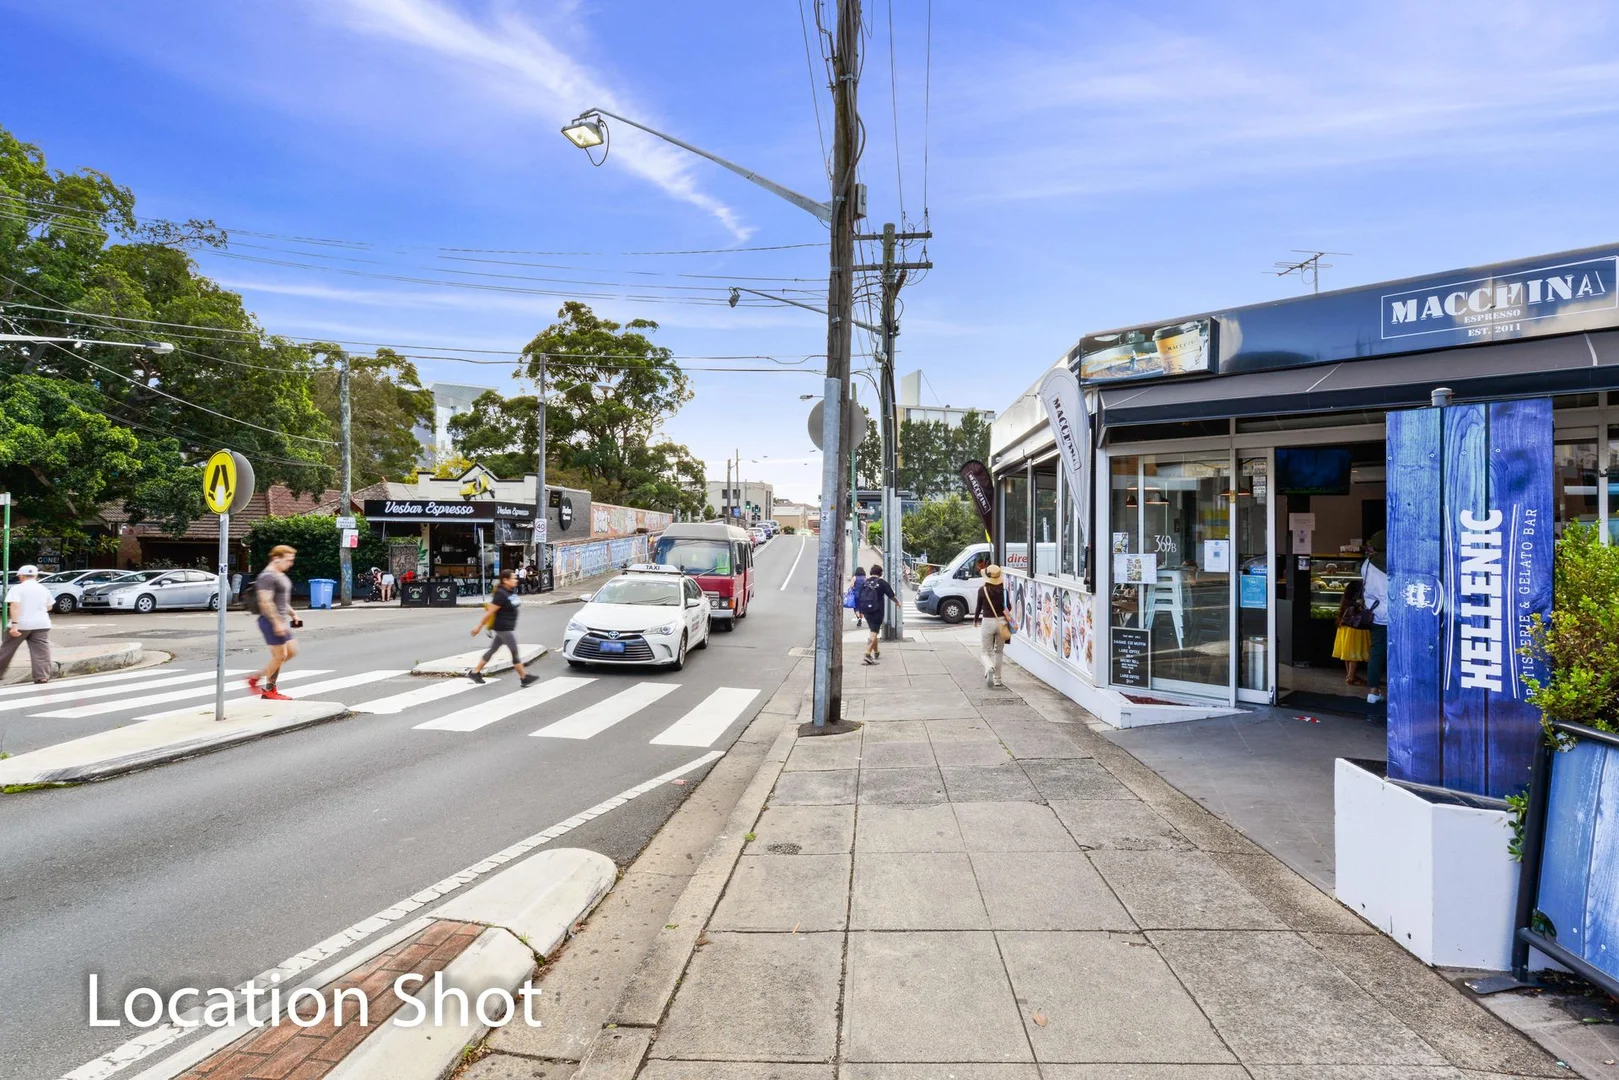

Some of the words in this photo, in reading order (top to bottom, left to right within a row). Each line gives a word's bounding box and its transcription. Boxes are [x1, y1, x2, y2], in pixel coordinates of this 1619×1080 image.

[1390, 269, 1607, 325] MACCHINA
[1463, 308, 1521, 325] ESPRESSO
[1467, 328, 1492, 338] EST.
[1494, 323, 1522, 334] 2011
[384, 501, 423, 514] Vesbar
[425, 502, 475, 516] Espresso
[1522, 508, 1538, 536] BAR
[1154, 534, 1177, 552] 369B
[1007, 553, 1028, 563] dire
[1518, 541, 1534, 595] GELATO
[1459, 509, 1503, 692] HELLENIC
[1519, 601, 1531, 609] &
[1518, 615, 1538, 697] PTISERIE
